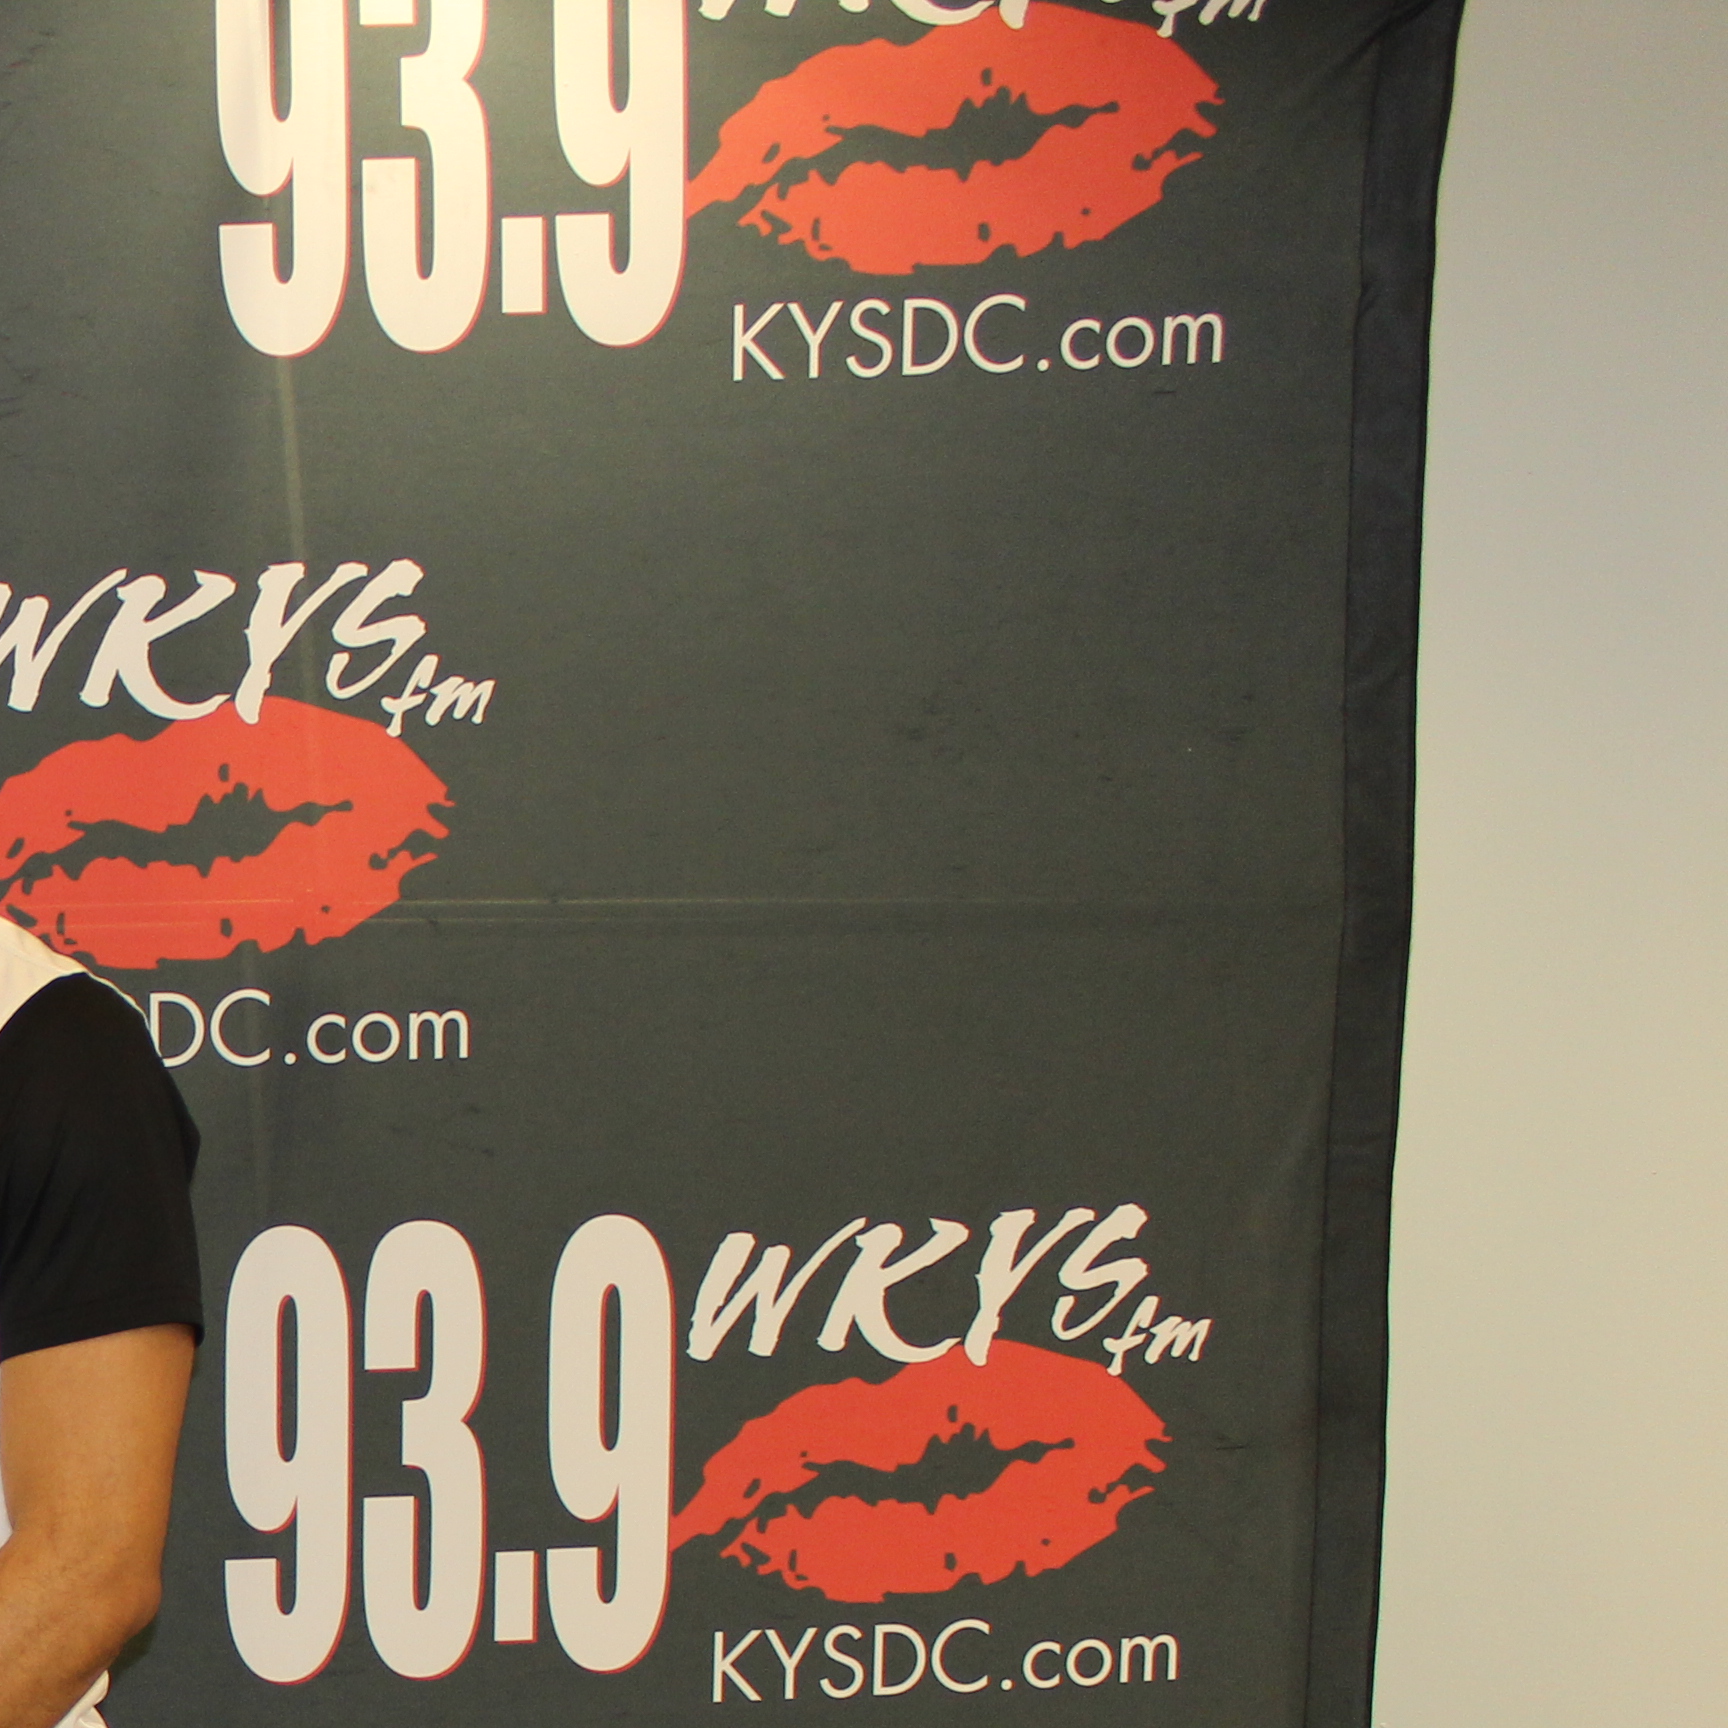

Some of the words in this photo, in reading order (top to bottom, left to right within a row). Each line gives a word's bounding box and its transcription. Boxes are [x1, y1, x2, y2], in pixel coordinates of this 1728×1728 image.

[215, 0, 688, 358] 93.9
[731, 293, 1225, 382] KYSDC.com
[148, 987, 470, 1068] DC.com
[686, 1203, 1149, 1368] WKYS
[224, 1213, 677, 1687] 93.9
[710, 1617, 1180, 1703] KYSDC.com
